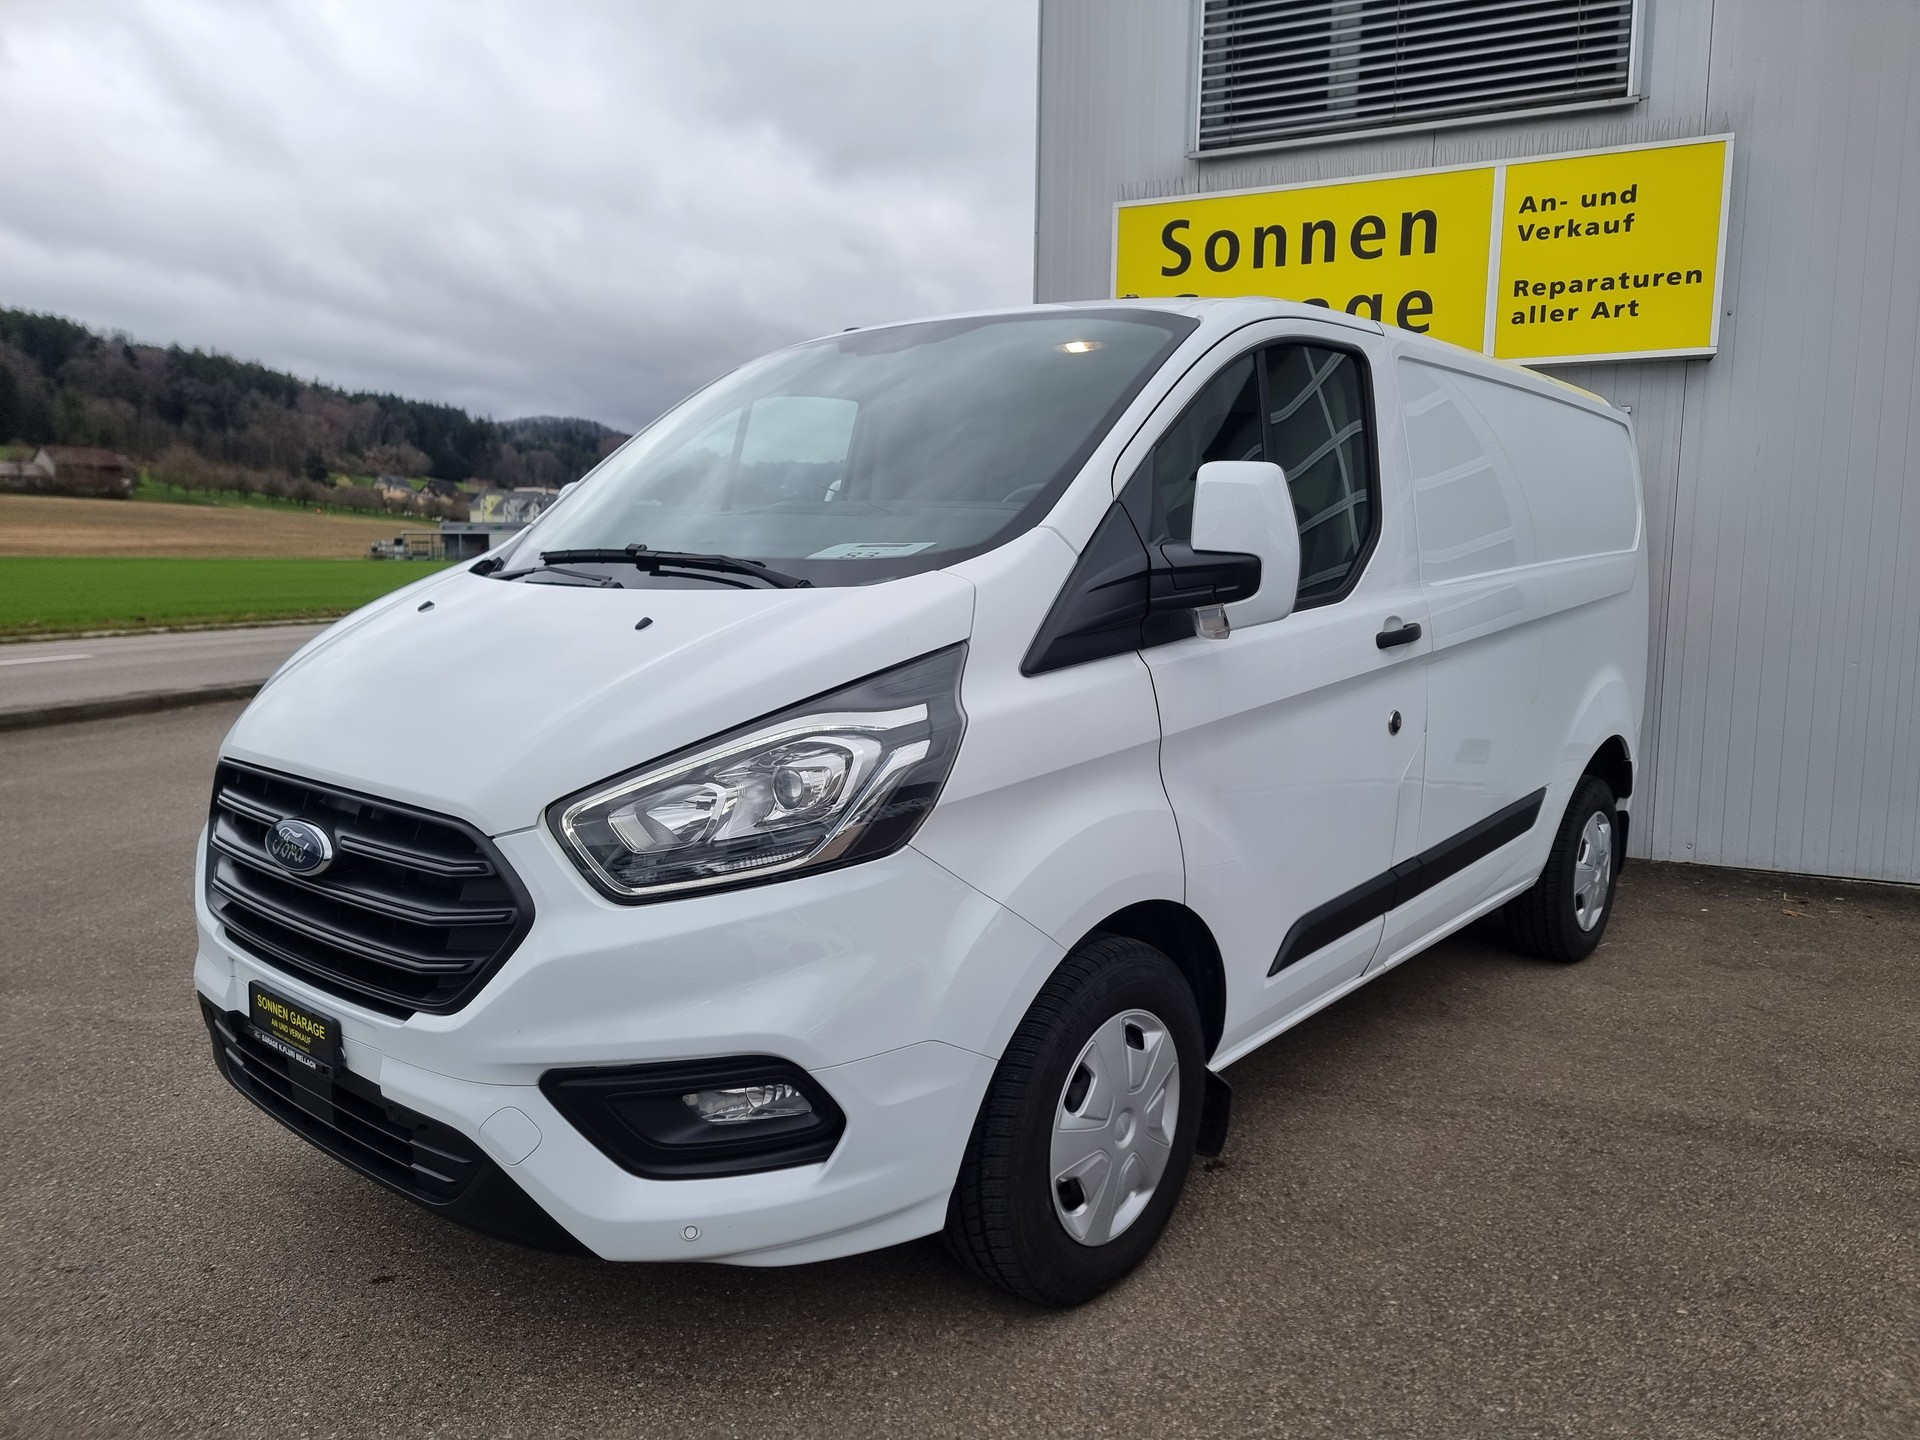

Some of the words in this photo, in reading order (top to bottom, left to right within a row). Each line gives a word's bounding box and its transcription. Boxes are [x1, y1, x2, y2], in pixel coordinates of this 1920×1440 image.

[1518, 195, 1568, 215] An-
[1581, 183, 1638, 208] und
[1160, 208, 1438, 278] Sonnen
[1517, 212, 1636, 242] Verkauf
[1513, 269, 1703, 300] Reparaturen
[1511, 304, 1579, 325] aller
[1590, 299, 1640, 320] Art
[272, 826, 310, 864] Ford
[257, 994, 288, 1021] SONNEN
[290, 1011, 325, 1039] GARAGE
